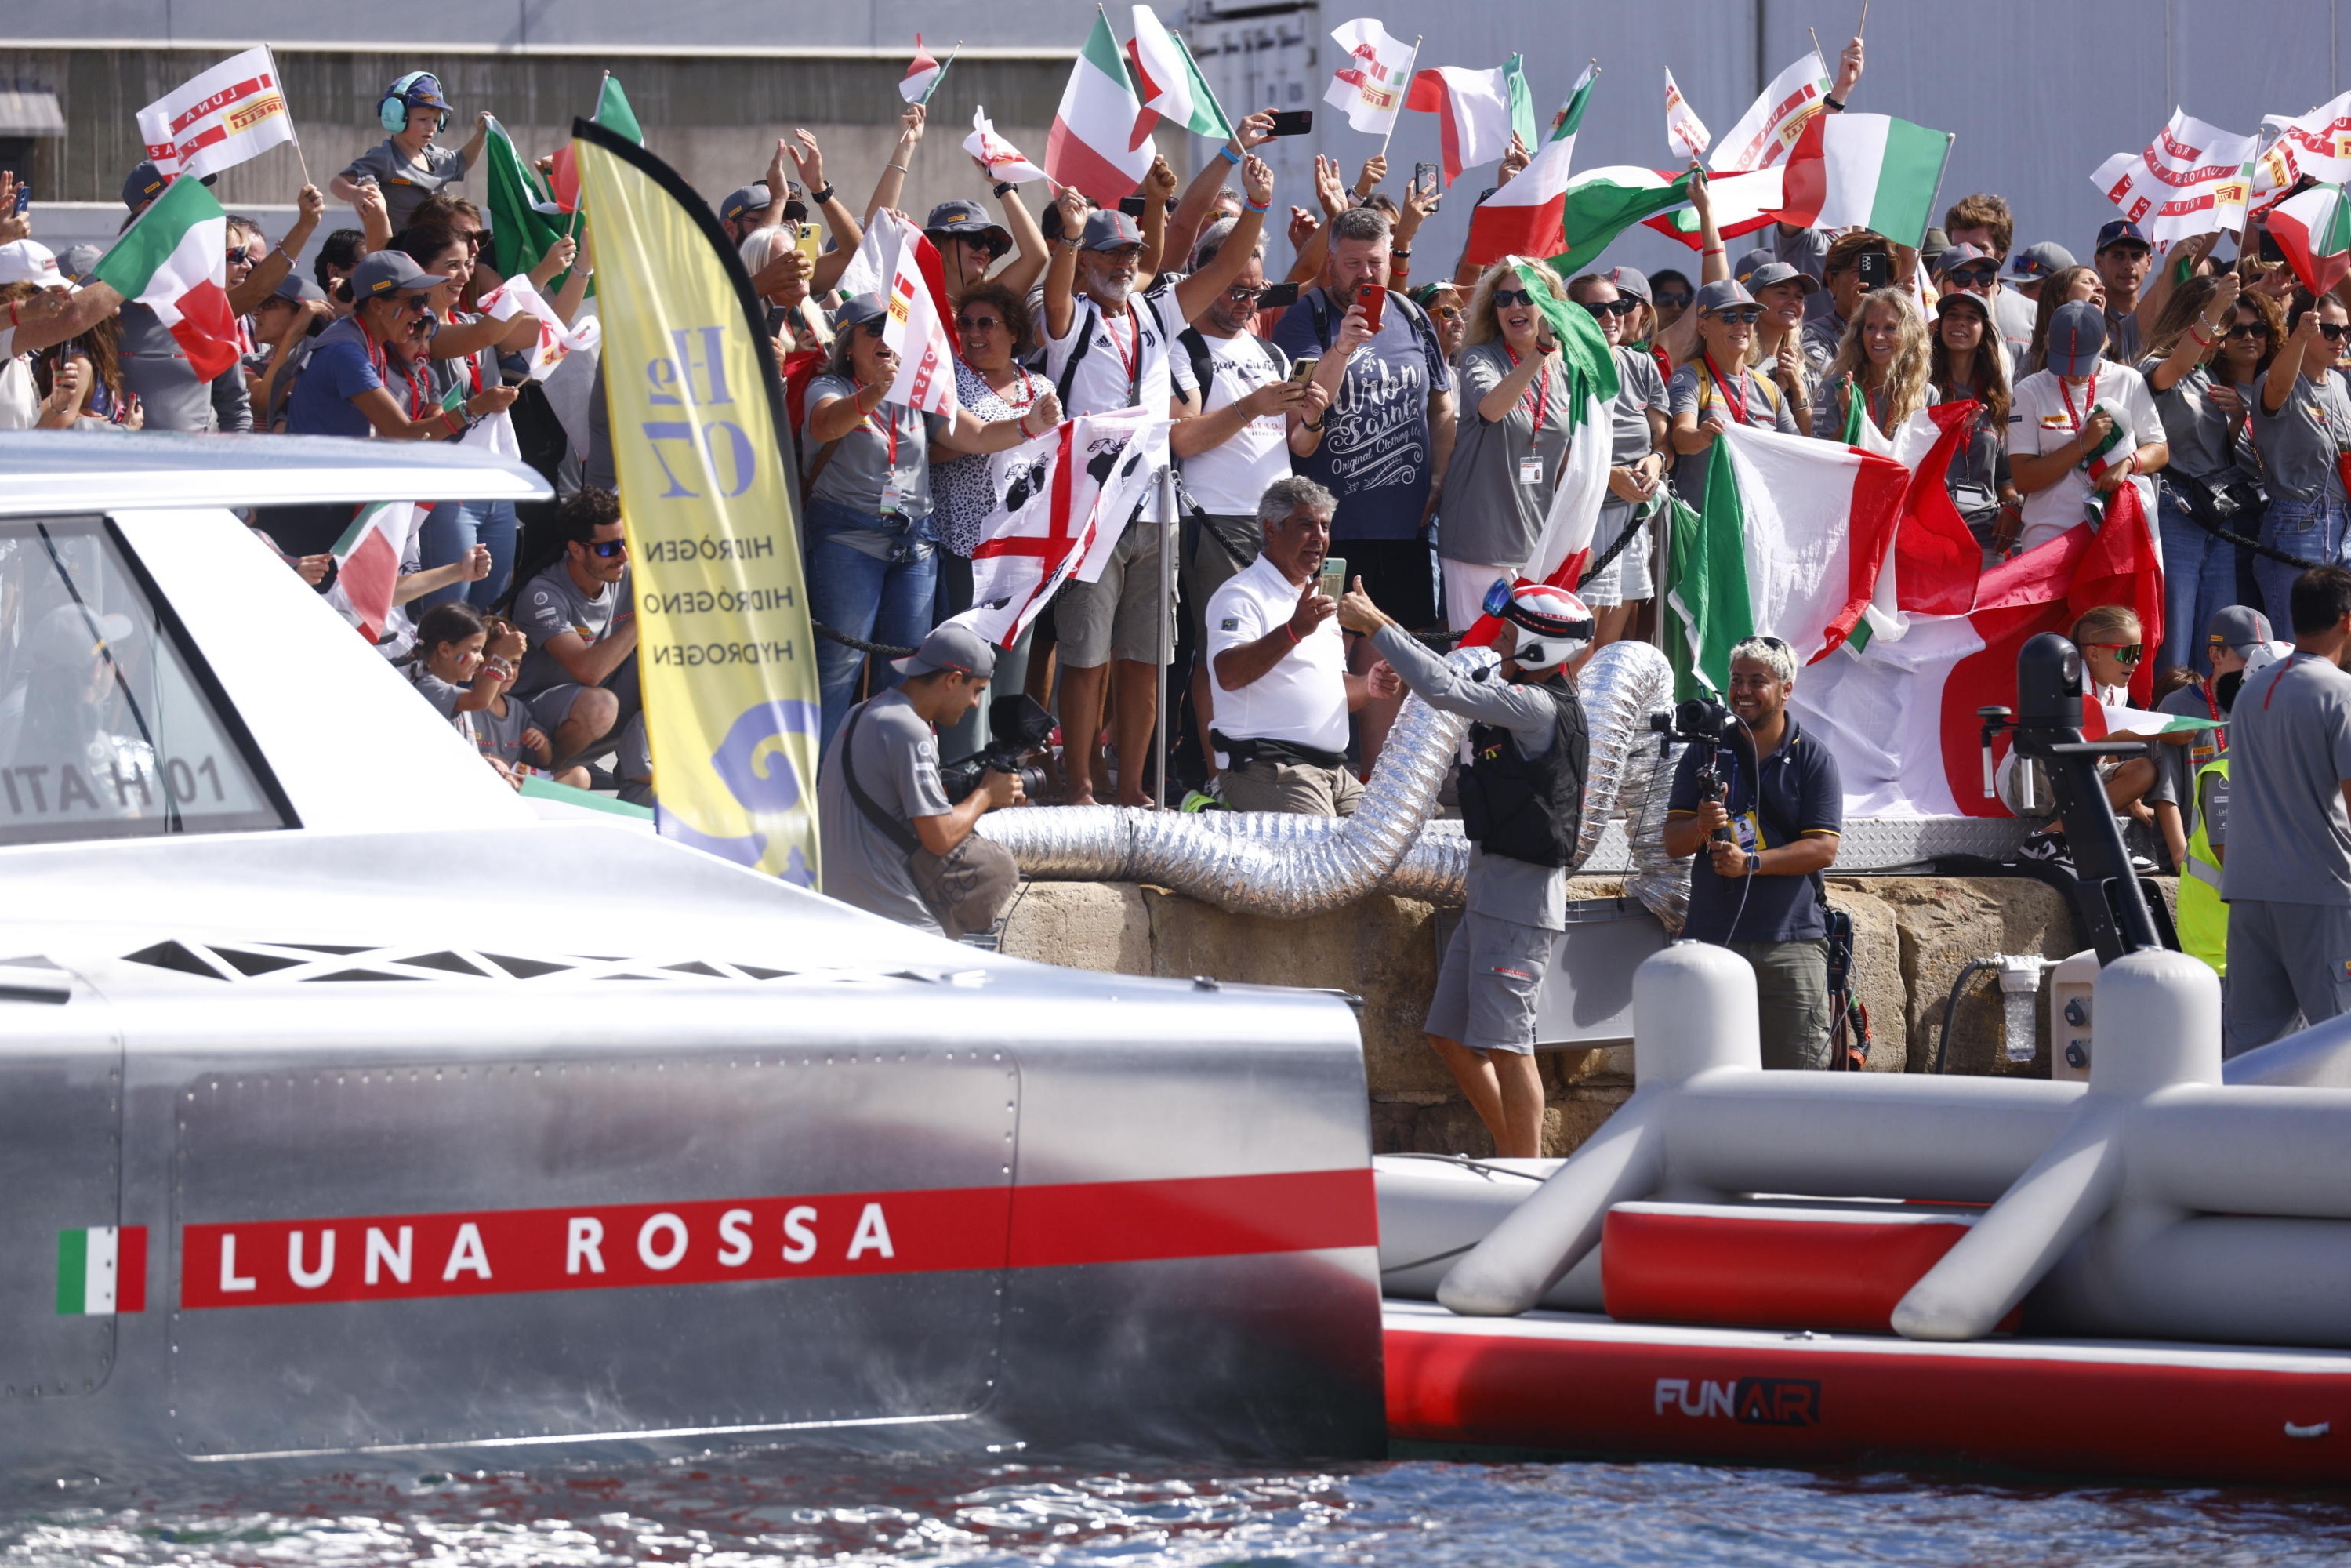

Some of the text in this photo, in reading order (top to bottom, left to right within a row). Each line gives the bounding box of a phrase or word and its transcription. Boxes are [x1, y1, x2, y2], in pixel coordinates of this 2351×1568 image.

[1332, 448, 1373, 474] Original
[1376, 433, 1409, 454] Clothing
[1, 754, 225, 815] ITA H 01
[220, 1203, 894, 1292] LUNA ROSSA
